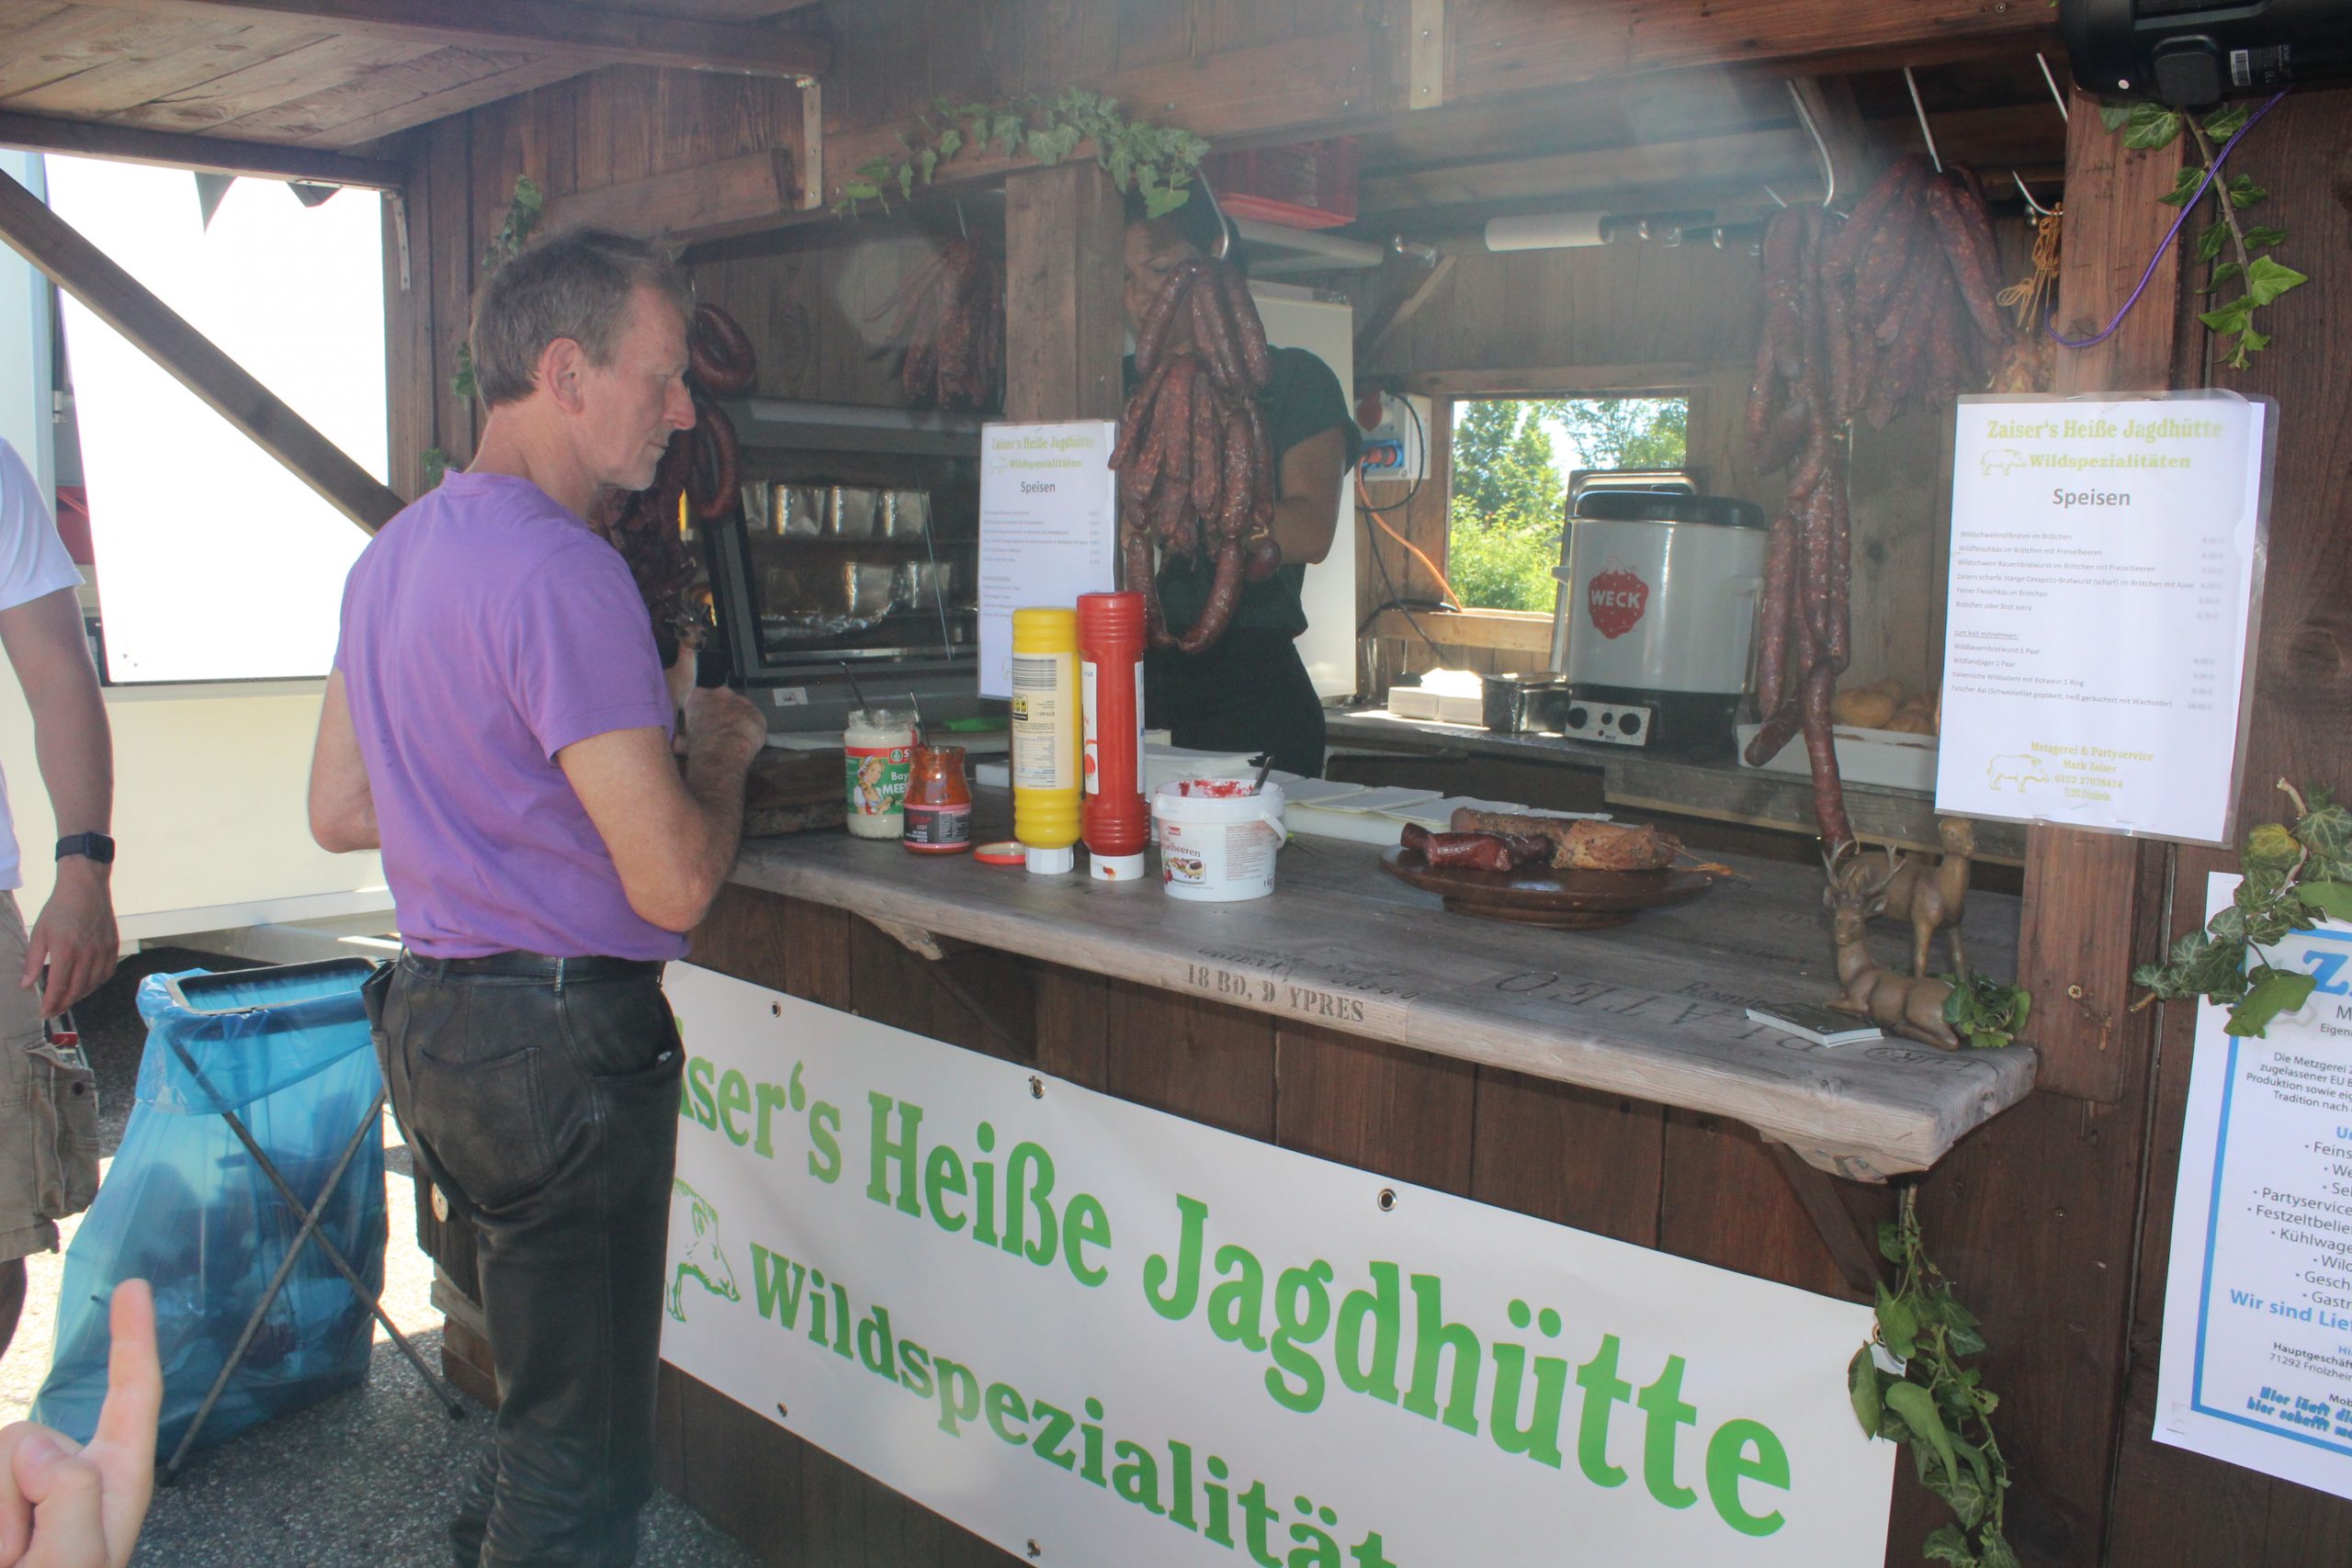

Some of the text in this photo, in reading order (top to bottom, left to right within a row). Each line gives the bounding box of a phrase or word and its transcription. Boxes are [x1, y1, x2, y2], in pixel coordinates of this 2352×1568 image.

[1986, 418, 2223, 444] Zaiser's Heiße Jagdhütte
[2029, 454, 2191, 470] Wildspezialitäten
[1021, 481, 1056, 495] Speisen
[2052, 488, 2131, 509] Speisen
[1961, 531, 2030, 540] Wildschweinrollbraten
[2041, 533, 2072, 541] Brötchen
[2057, 548, 2102, 557] Preiselbeeren
[1998, 560, 2051, 570] Bauernbratwurst
[2064, 562, 2094, 570] Brötchen
[2109, 565, 2155, 573] Preiselbeeren
[2004, 575, 2025, 583] Stange
[2131, 580, 2162, 588] Brötchen
[1590, 589, 1642, 609] WECK
[1956, 601, 1983, 609] Brötchen
[1953, 643, 2018, 654] Wildbauernbratwurst
[2034, 677, 2062, 685] Rotwein
[2069, 679, 2085, 688] Ring
[2119, 696, 2131, 705] mit
[2030, 741, 2154, 761] Metzgerei & Partyservice
[2089, 761, 2117, 773] Zaiser
[1189, 964, 1210, 988] 18
[1288, 985, 1364, 1023] YPRES
[2274, 1052, 2291, 1064] Die
[2293, 1055, 2346, 1074] Metzgerei
[2246, 1073, 2302, 1091] Produktion
[2305, 1085, 2336, 1098] sowie
[2259, 1064, 2327, 1084] zugelassener
[2330, 1077, 2345, 1087] EU
[2274, 1090, 2348, 1112] Tradition nach
[2262, 1187, 2352, 1216] Partyservice
[2256, 1204, 2352, 1235] Festzeltbelie
[2304, 1270, 2352, 1291] Gesch
[866, 1089, 1112, 1288] Heiße
[1143, 1192, 1791, 1537] Jagdhütte
[2230, 1289, 2264, 1310] Wir
[2269, 1301, 2312, 1323] sind
[2270, 1353, 2301, 1369] 71292
[2259, 1385, 2291, 1406] Hier
[2246, 1396, 2276, 1416] hier
